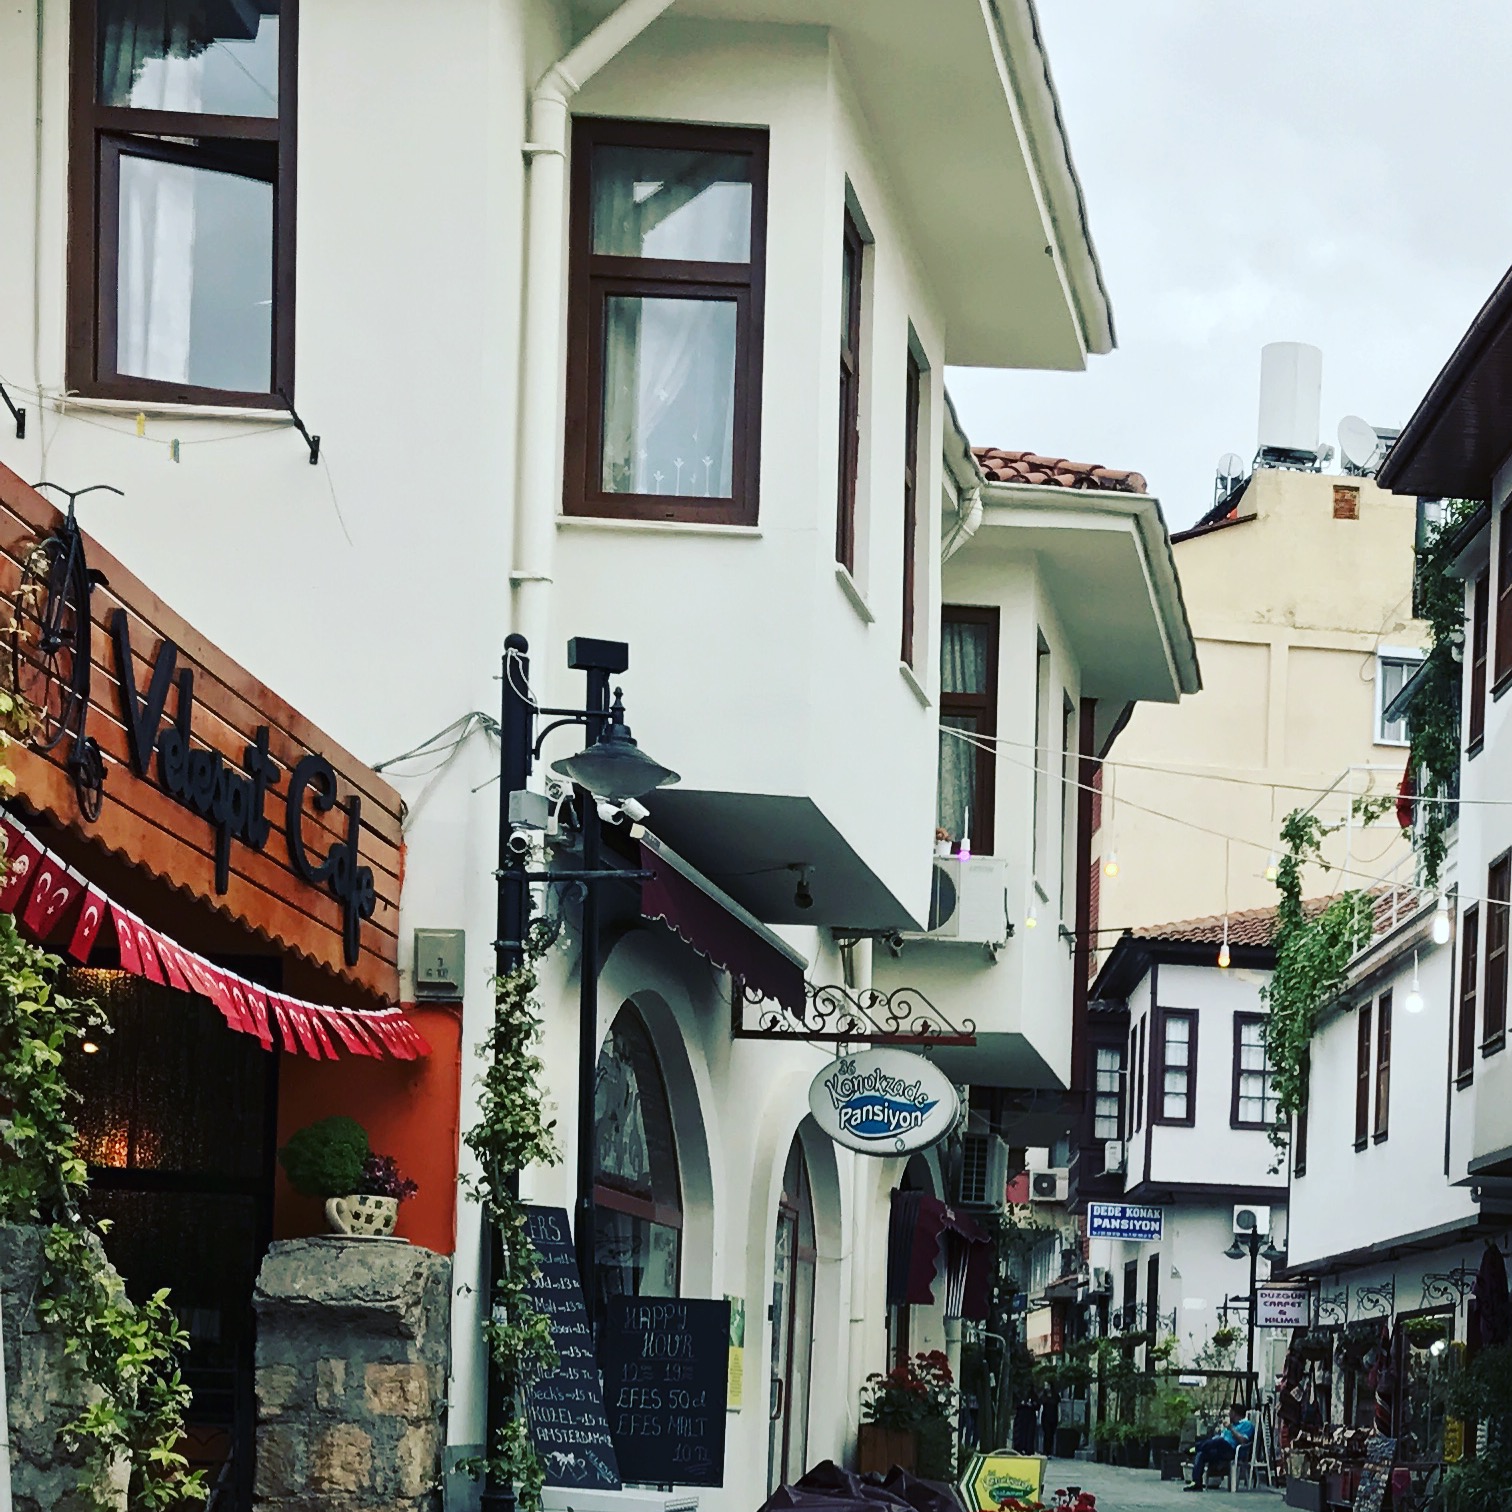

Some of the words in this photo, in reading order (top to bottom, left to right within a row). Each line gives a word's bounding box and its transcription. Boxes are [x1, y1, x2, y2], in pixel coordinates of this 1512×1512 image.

[285, 754, 377, 968] Cafe
[825, 1068, 930, 1110] Konukzade
[839, 1102, 923, 1131] Pansiyon
[1093, 1206, 1121, 1217] DEDE
[1126, 1208, 1160, 1219] KONAK
[624, 1303, 687, 1330] HAPPY
[642, 1332, 694, 1358] HOUR
[616, 1387, 662, 1409] EFES
[616, 1413, 662, 1436] EFES
